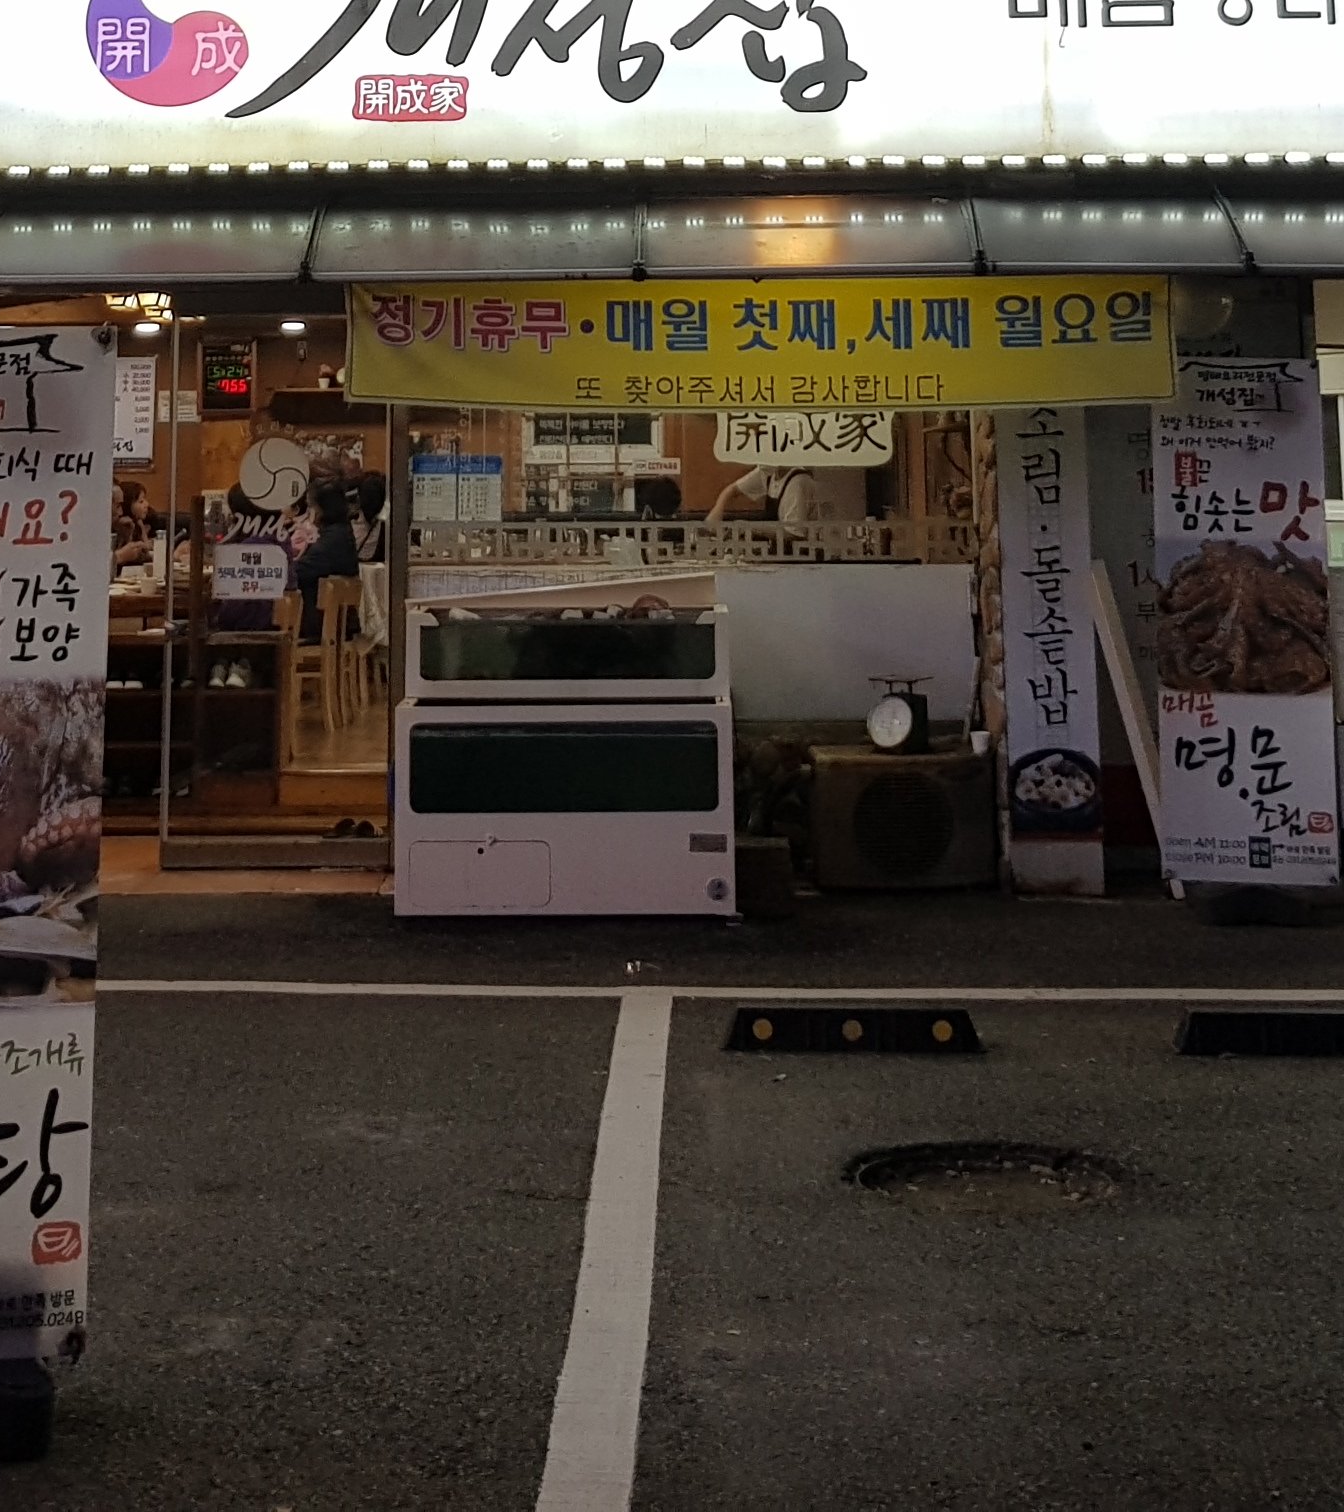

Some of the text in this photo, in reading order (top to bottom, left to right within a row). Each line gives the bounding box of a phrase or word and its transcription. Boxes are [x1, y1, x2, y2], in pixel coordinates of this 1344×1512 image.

[358, 78, 465, 117] 開成家
[732, 293, 972, 355] 첫째,세째
[994, 289, 1155, 349] 월요일
[575, 372, 945, 402] 또 찾아주셔서 감사합니다
[1196, 388, 1254, 406] 개성집
[53, 450, 94, 476] 때
[1171, 481, 1320, 541] 힘솟는 맛
[241, 552, 262, 565] 매월
[11, 562, 81, 612] 가족
[10, 617, 81, 662] 보양
[1020, 545, 1078, 727] 돌솥밥
[1251, 800, 1308, 837] 조림
